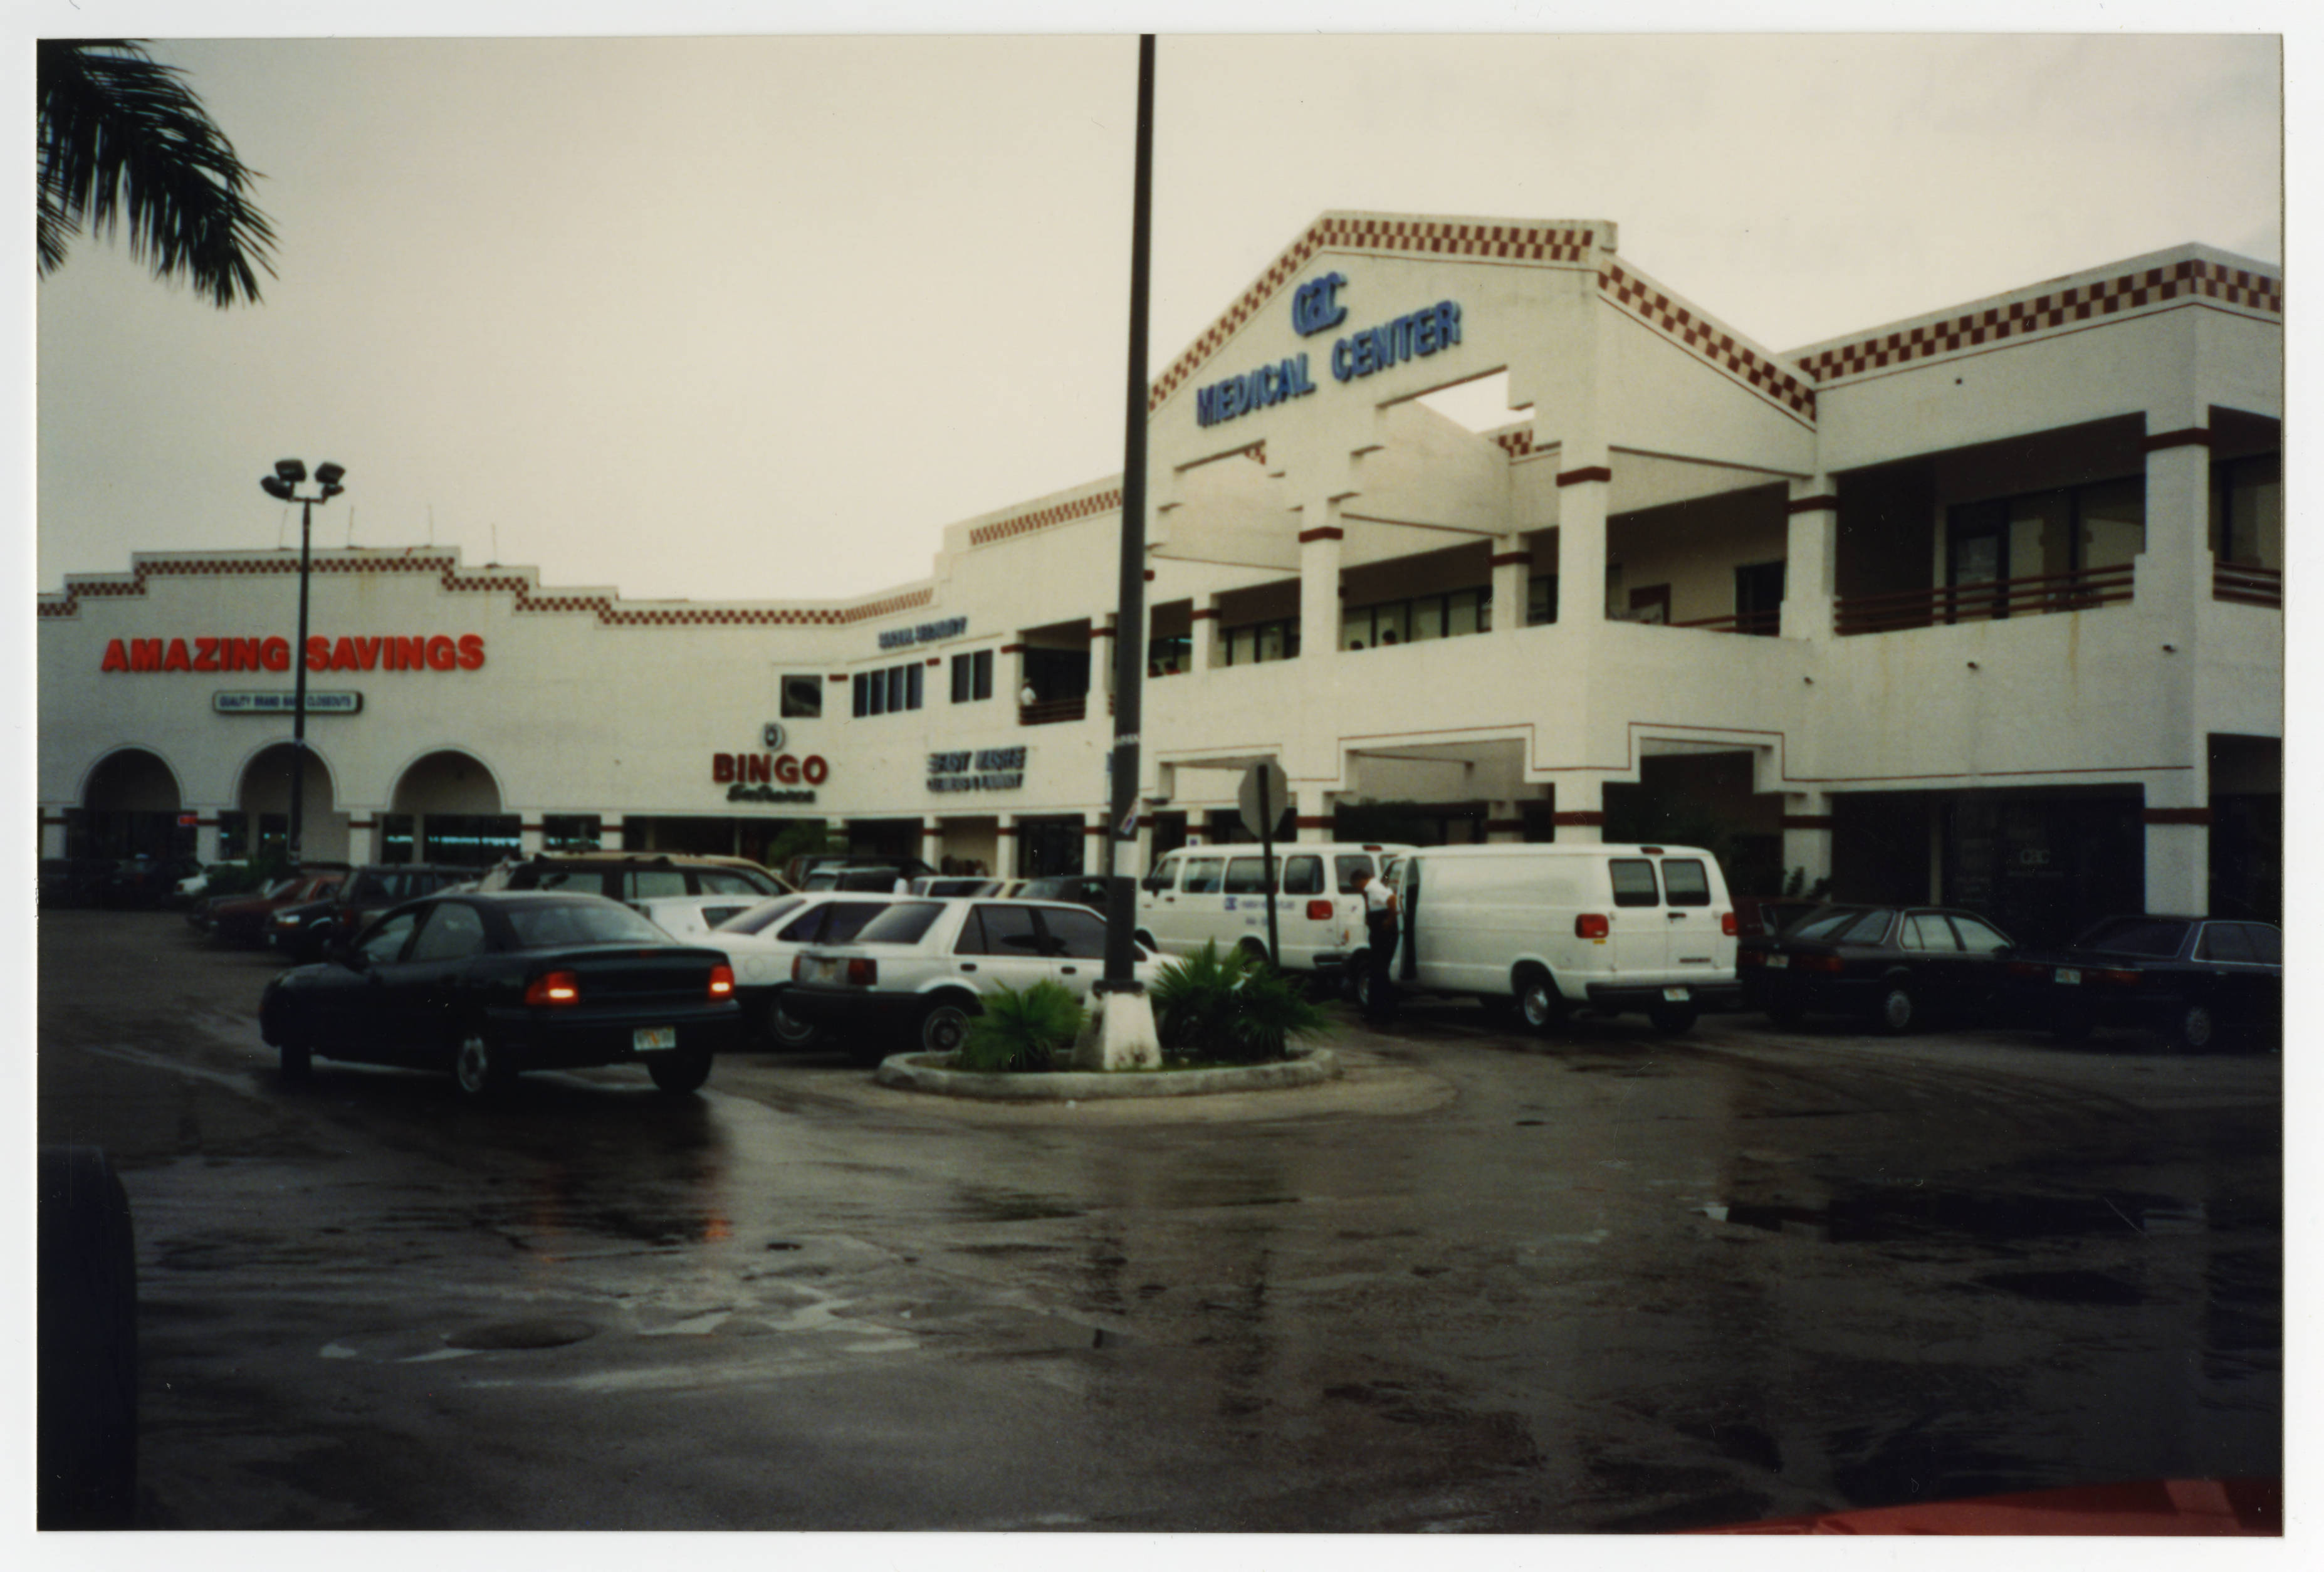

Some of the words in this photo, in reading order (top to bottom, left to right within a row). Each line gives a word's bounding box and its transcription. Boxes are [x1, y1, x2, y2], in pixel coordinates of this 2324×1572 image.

[1196, 352, 1317, 428] MEDICAL
[1331, 300, 1462, 384] CENTER
[101, 636, 291, 673] AMAZING
[306, 634, 486, 671] SAVINGS
[713, 752, 829, 786] BINGO
